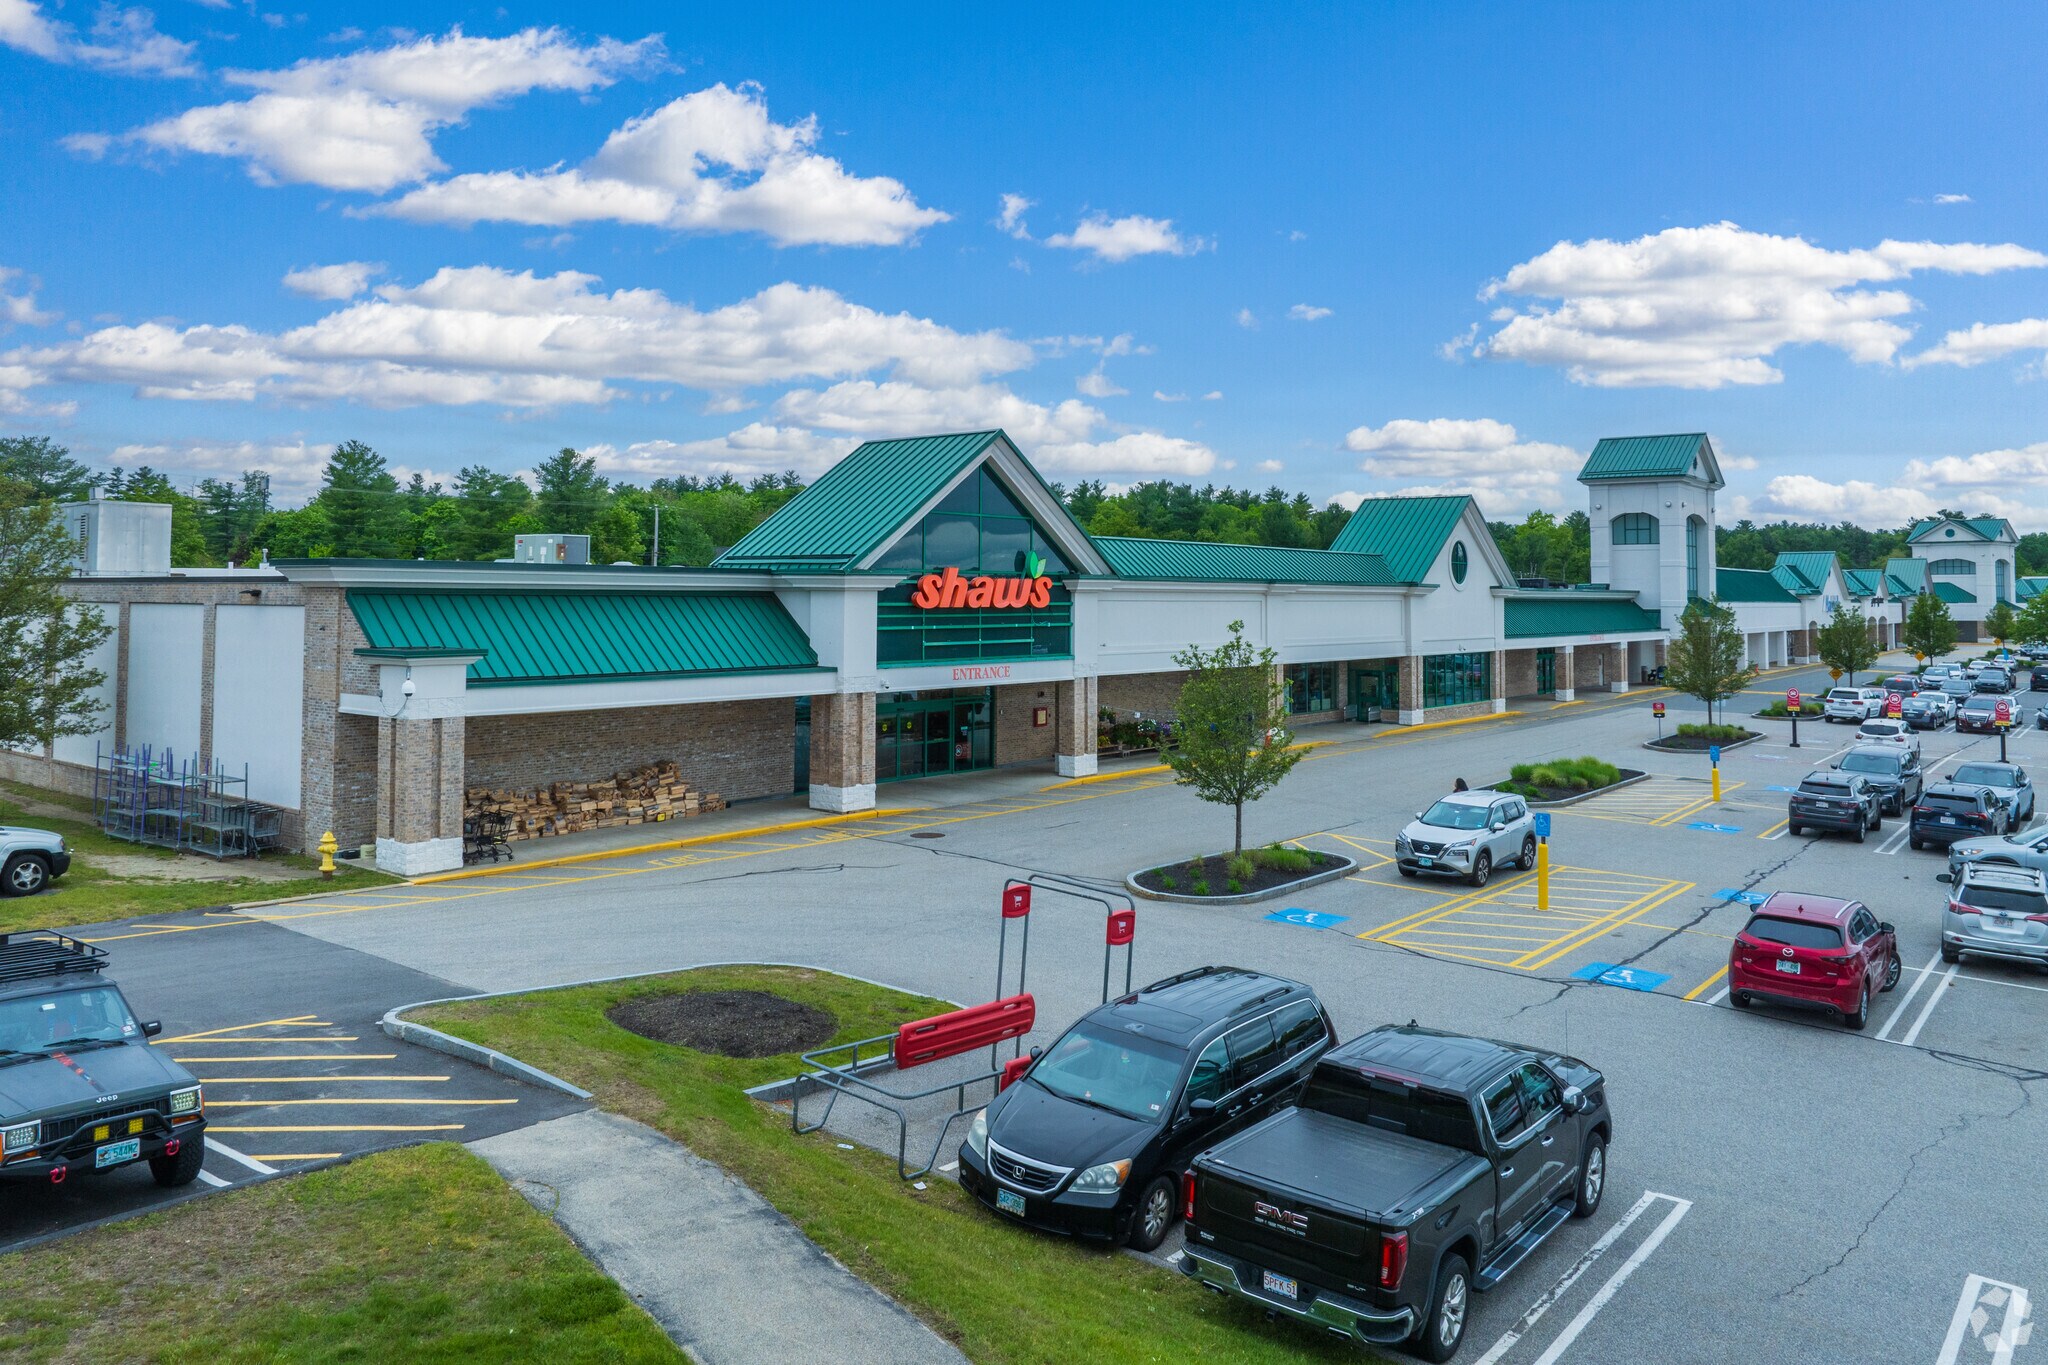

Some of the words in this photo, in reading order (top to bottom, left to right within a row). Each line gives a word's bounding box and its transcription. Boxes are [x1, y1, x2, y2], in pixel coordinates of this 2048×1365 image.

[952, 665, 1011, 681] ENTRANCE
[96, 1094, 118, 1104] Jeep
[1254, 1201, 1309, 1228] GMC
